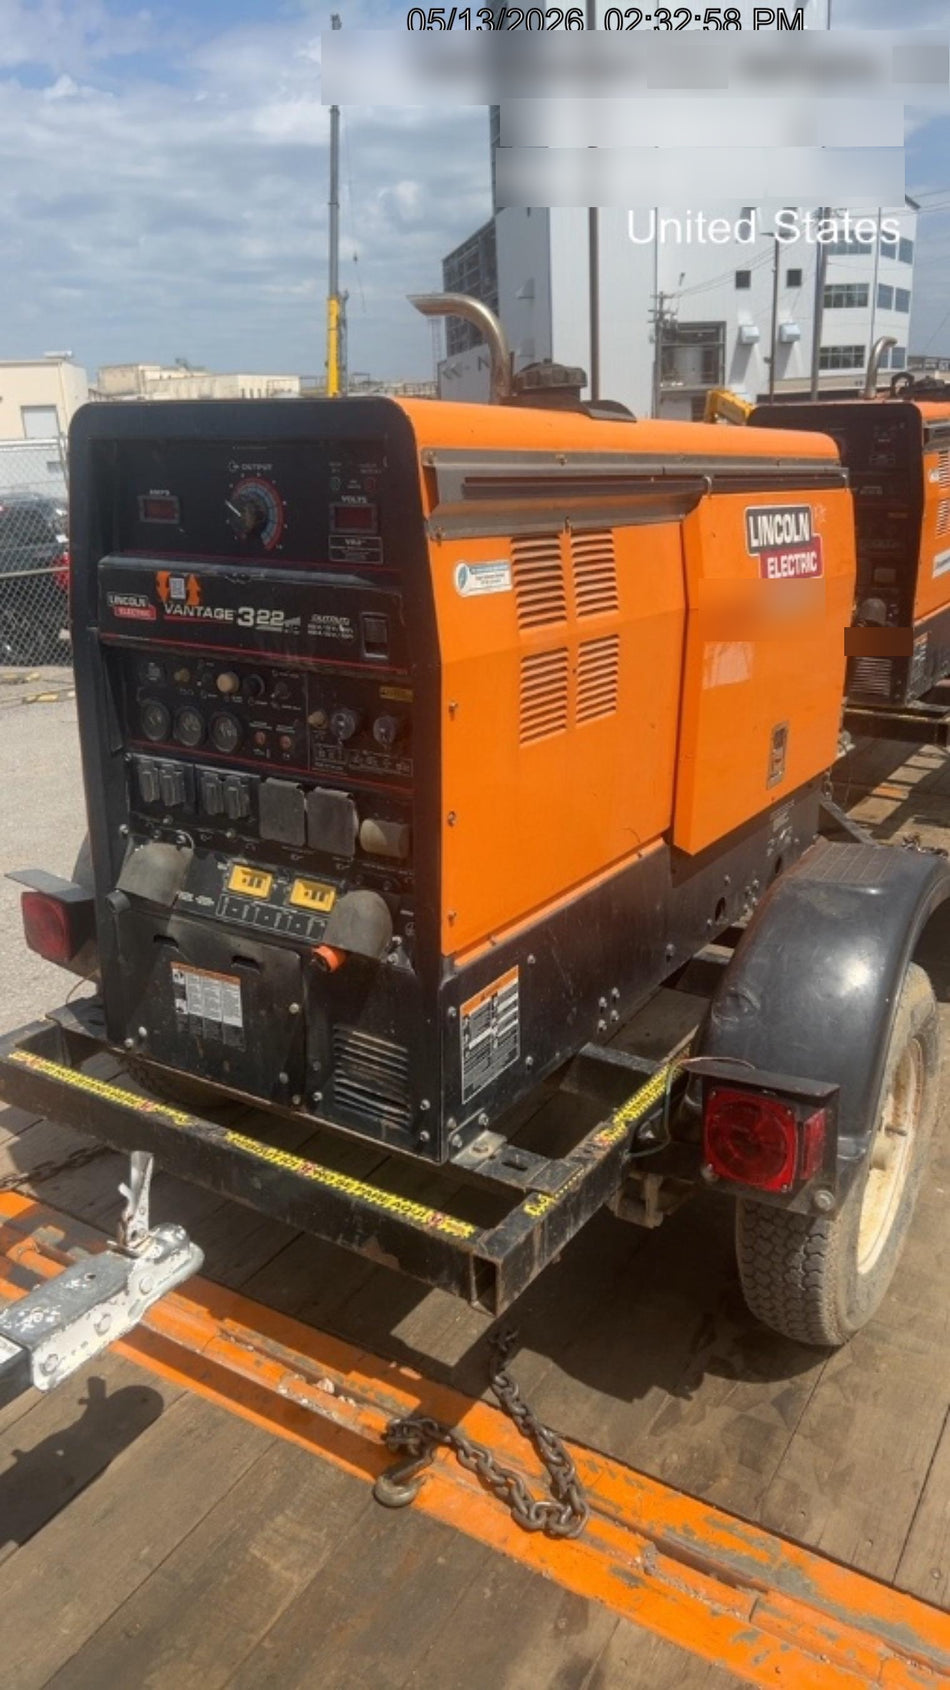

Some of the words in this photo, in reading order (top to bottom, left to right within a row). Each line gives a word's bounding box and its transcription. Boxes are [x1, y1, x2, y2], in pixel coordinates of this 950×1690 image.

[748, 512, 810, 547] LINCOLN
[767, 551, 818, 579] ELECTRIC
[109, 594, 147, 607] LINCOLN
[164, 603, 234, 621] VANTAGE
[237, 606, 285, 627] 322
